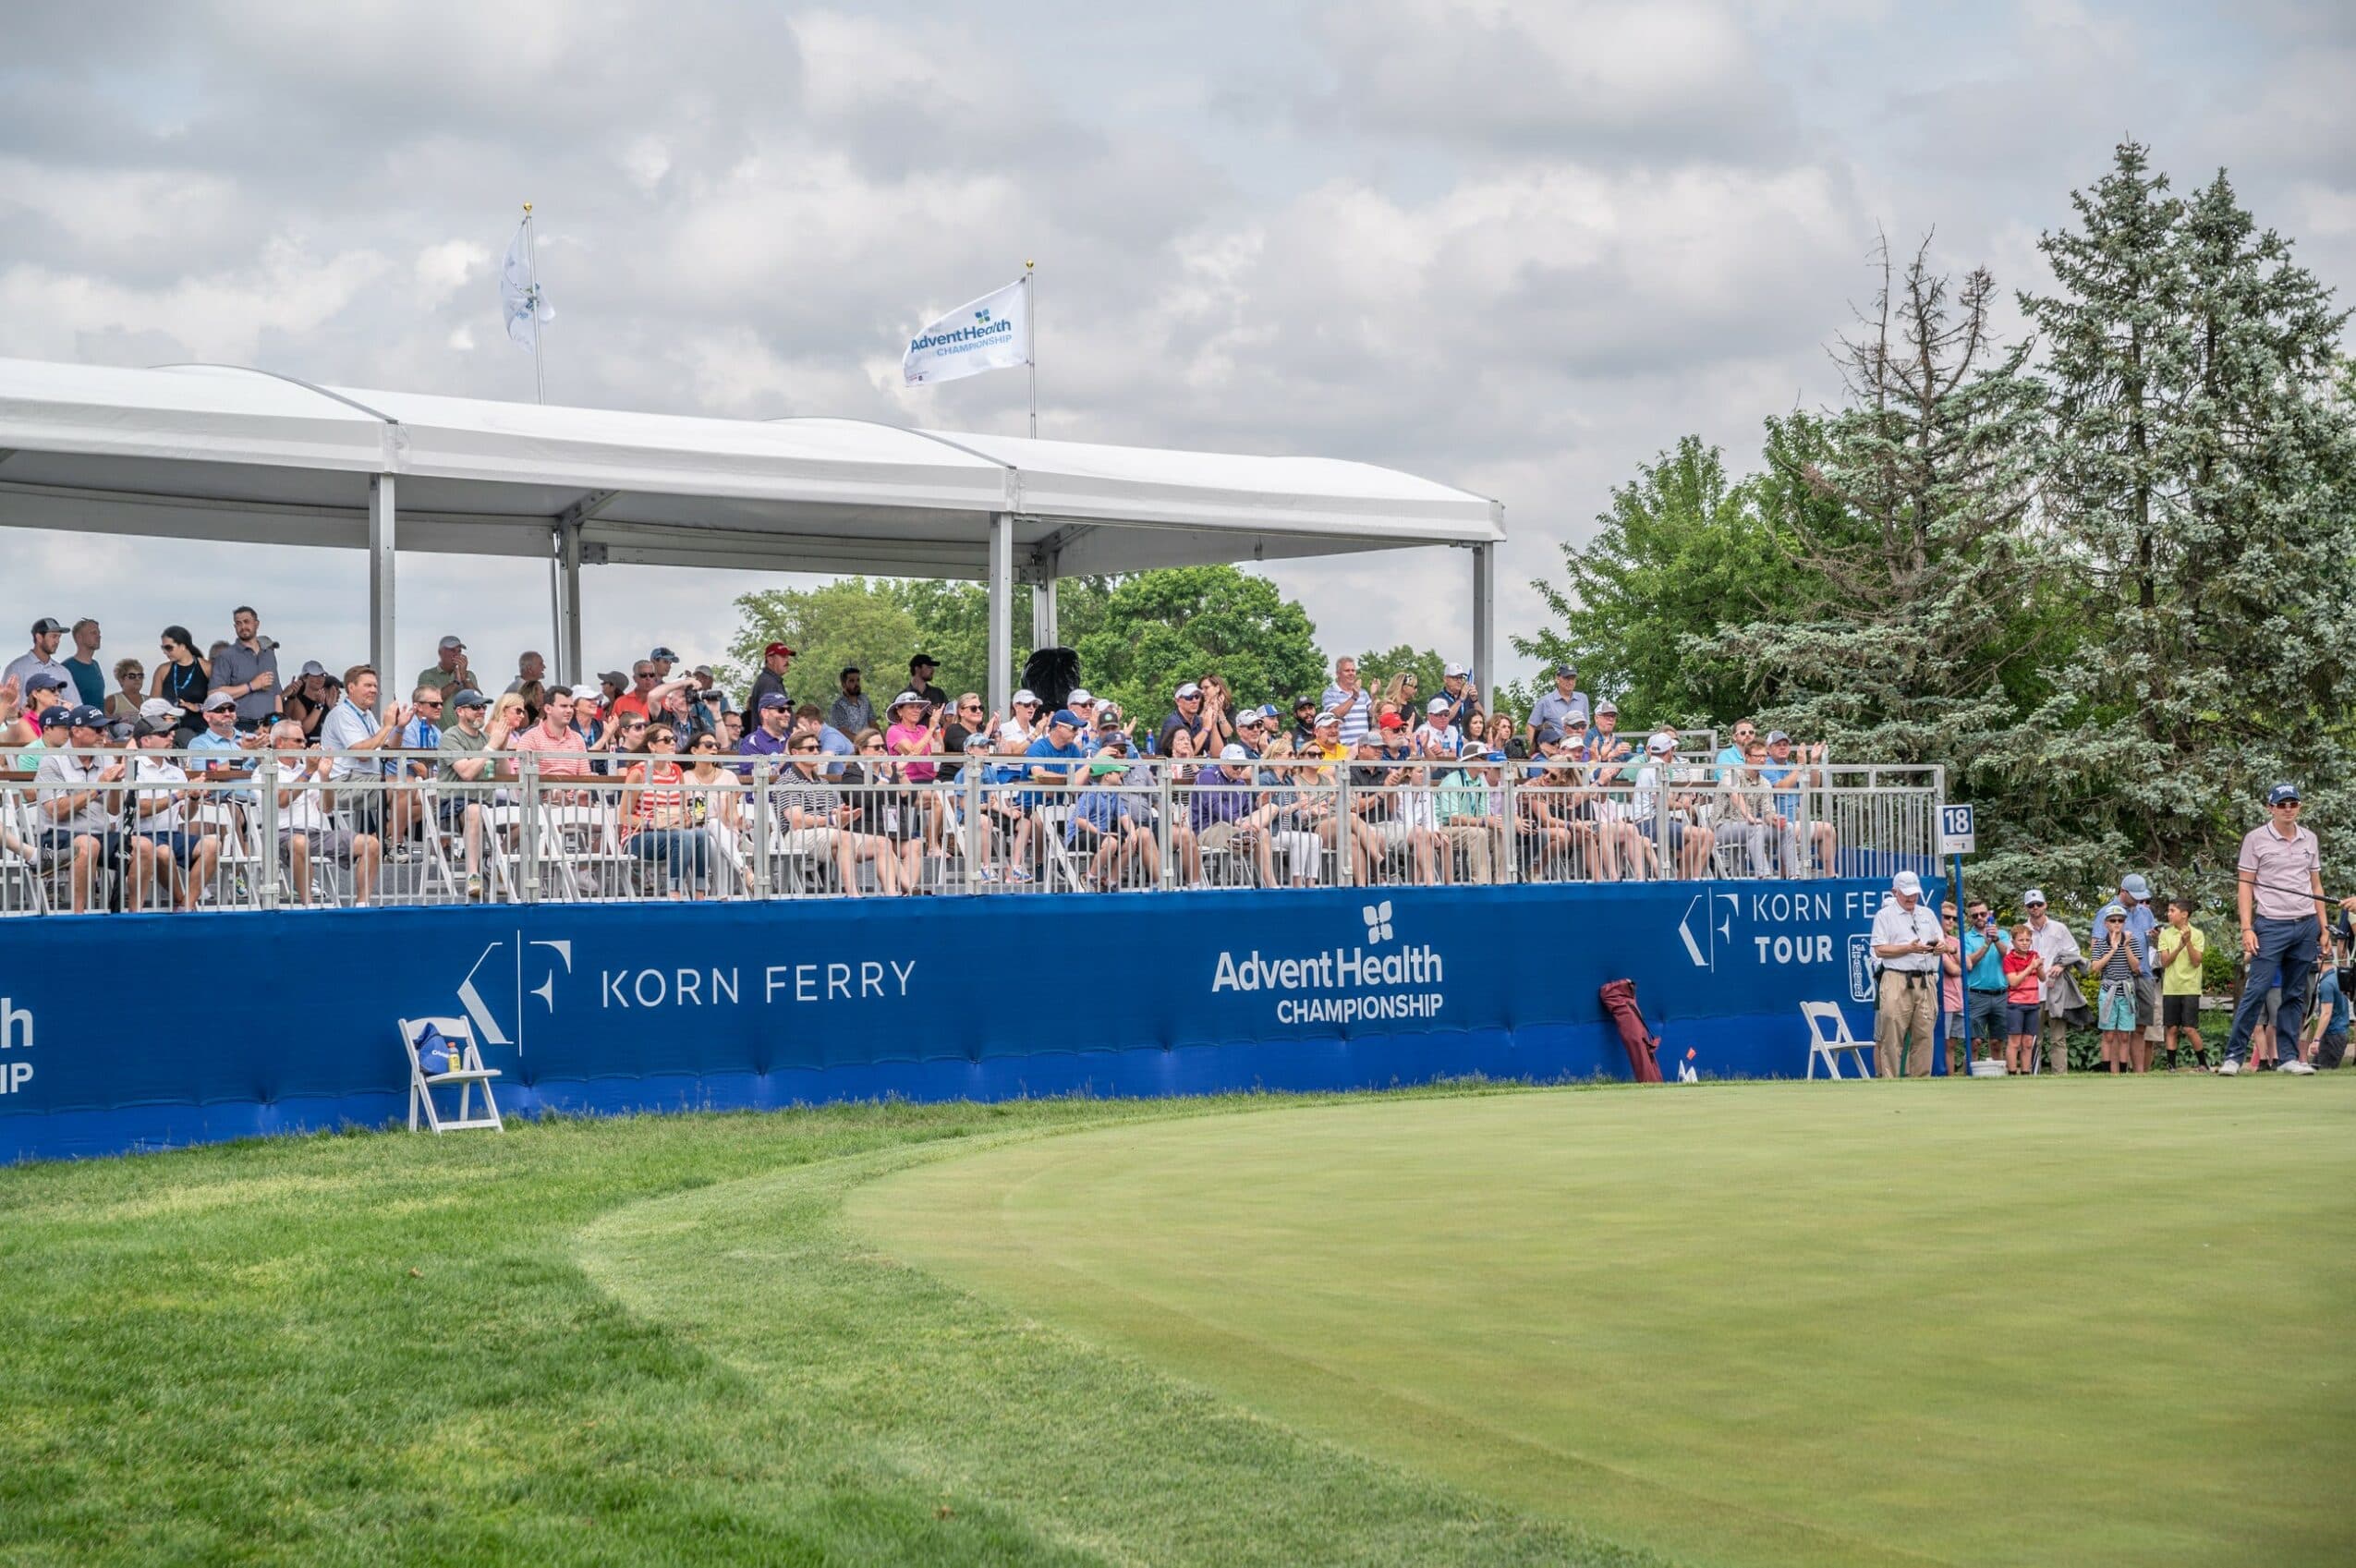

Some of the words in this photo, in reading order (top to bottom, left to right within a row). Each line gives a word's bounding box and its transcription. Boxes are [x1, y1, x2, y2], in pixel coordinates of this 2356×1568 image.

[911, 319, 1012, 353] AdventHealth
[937, 334, 1013, 357] CHAMPIONSHIP
[1945, 808, 1969, 833] 18
[1753, 893, 1831, 921] KORN
[1845, 889, 1935, 919] FEY
[1755, 935, 1833, 964] TOUR
[1211, 944, 1443, 992] AdventHealth
[602, 967, 738, 1008] KORN
[766, 960, 916, 1003] FERRY
[1277, 993, 1443, 1024] CHAMPIONSHIP
